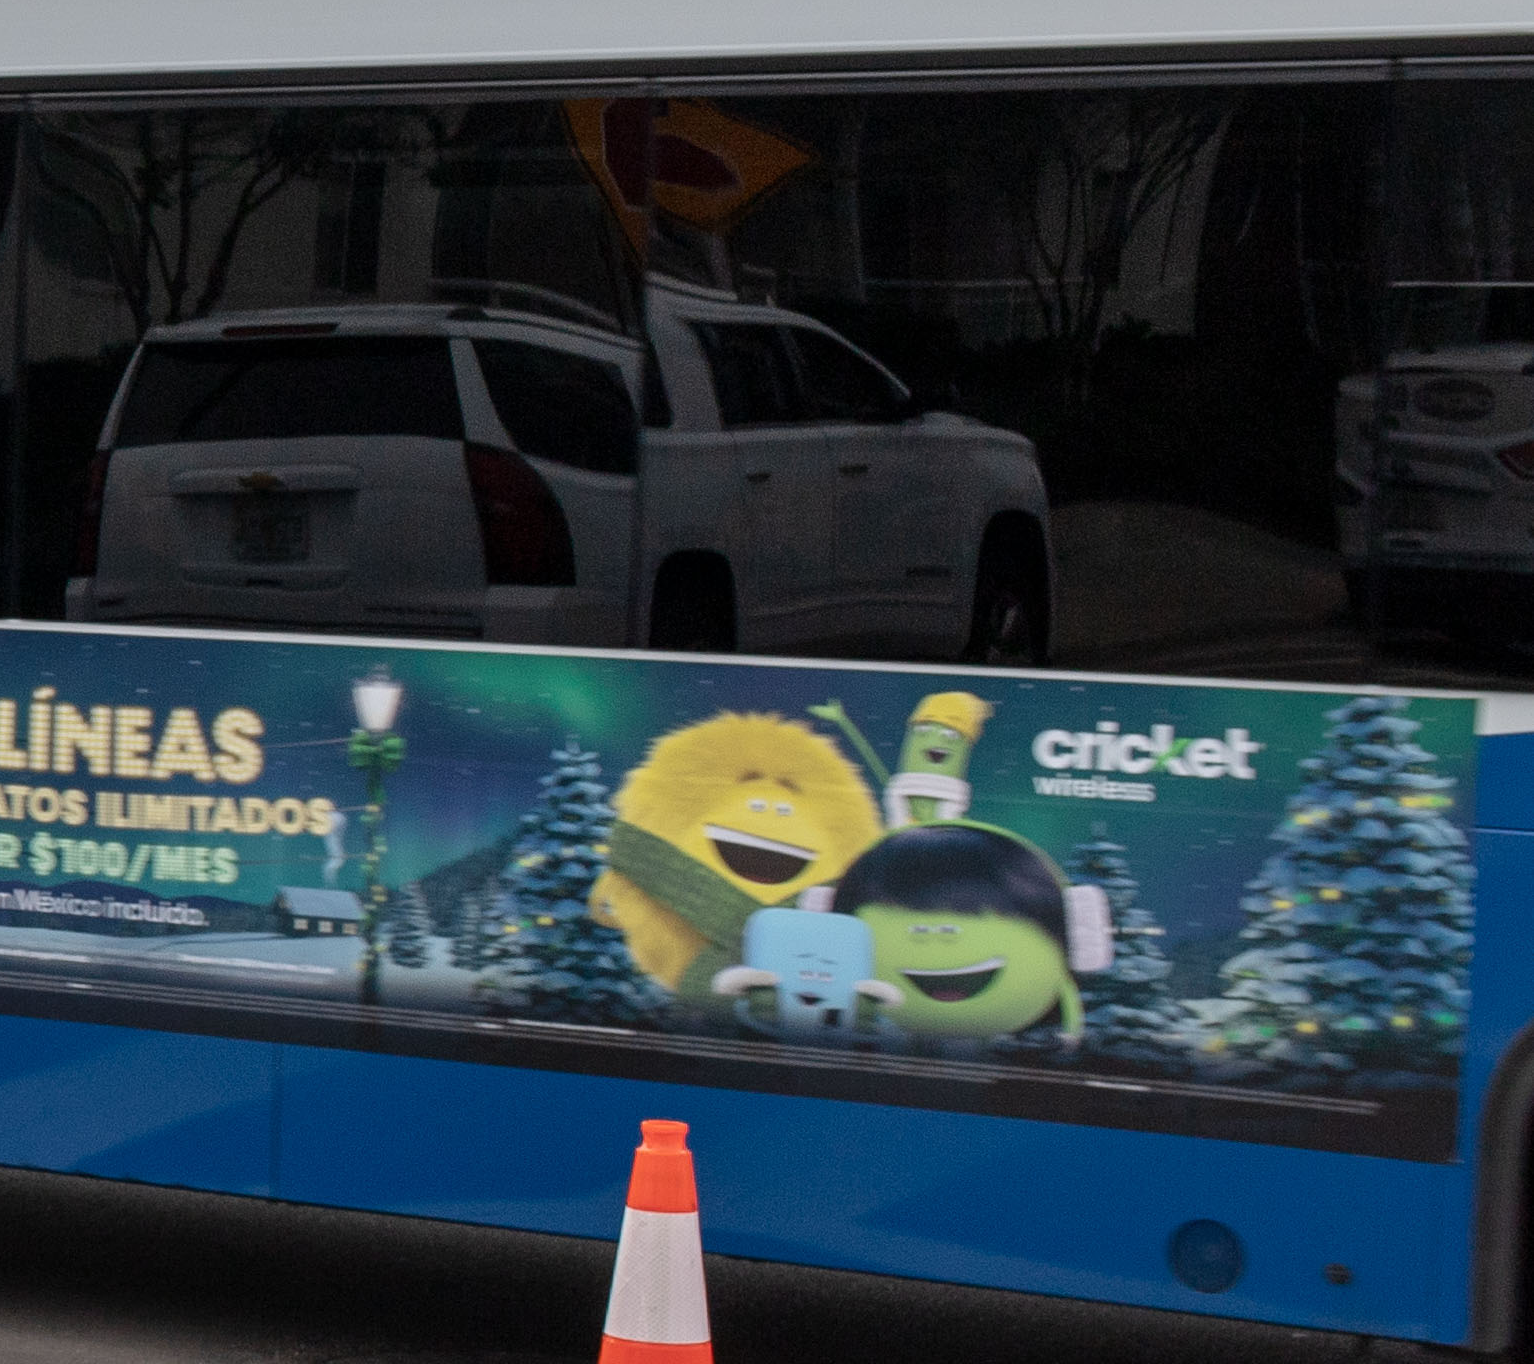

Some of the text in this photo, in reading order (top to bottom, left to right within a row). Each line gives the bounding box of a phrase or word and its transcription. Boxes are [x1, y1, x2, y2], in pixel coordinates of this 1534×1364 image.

[1031, 720, 1261, 780] cricket
[1032, 773, 1157, 803] wireless
[95, 791, 336, 837] ILIMITADOS
[29, 831, 240, 885] $100/MES
